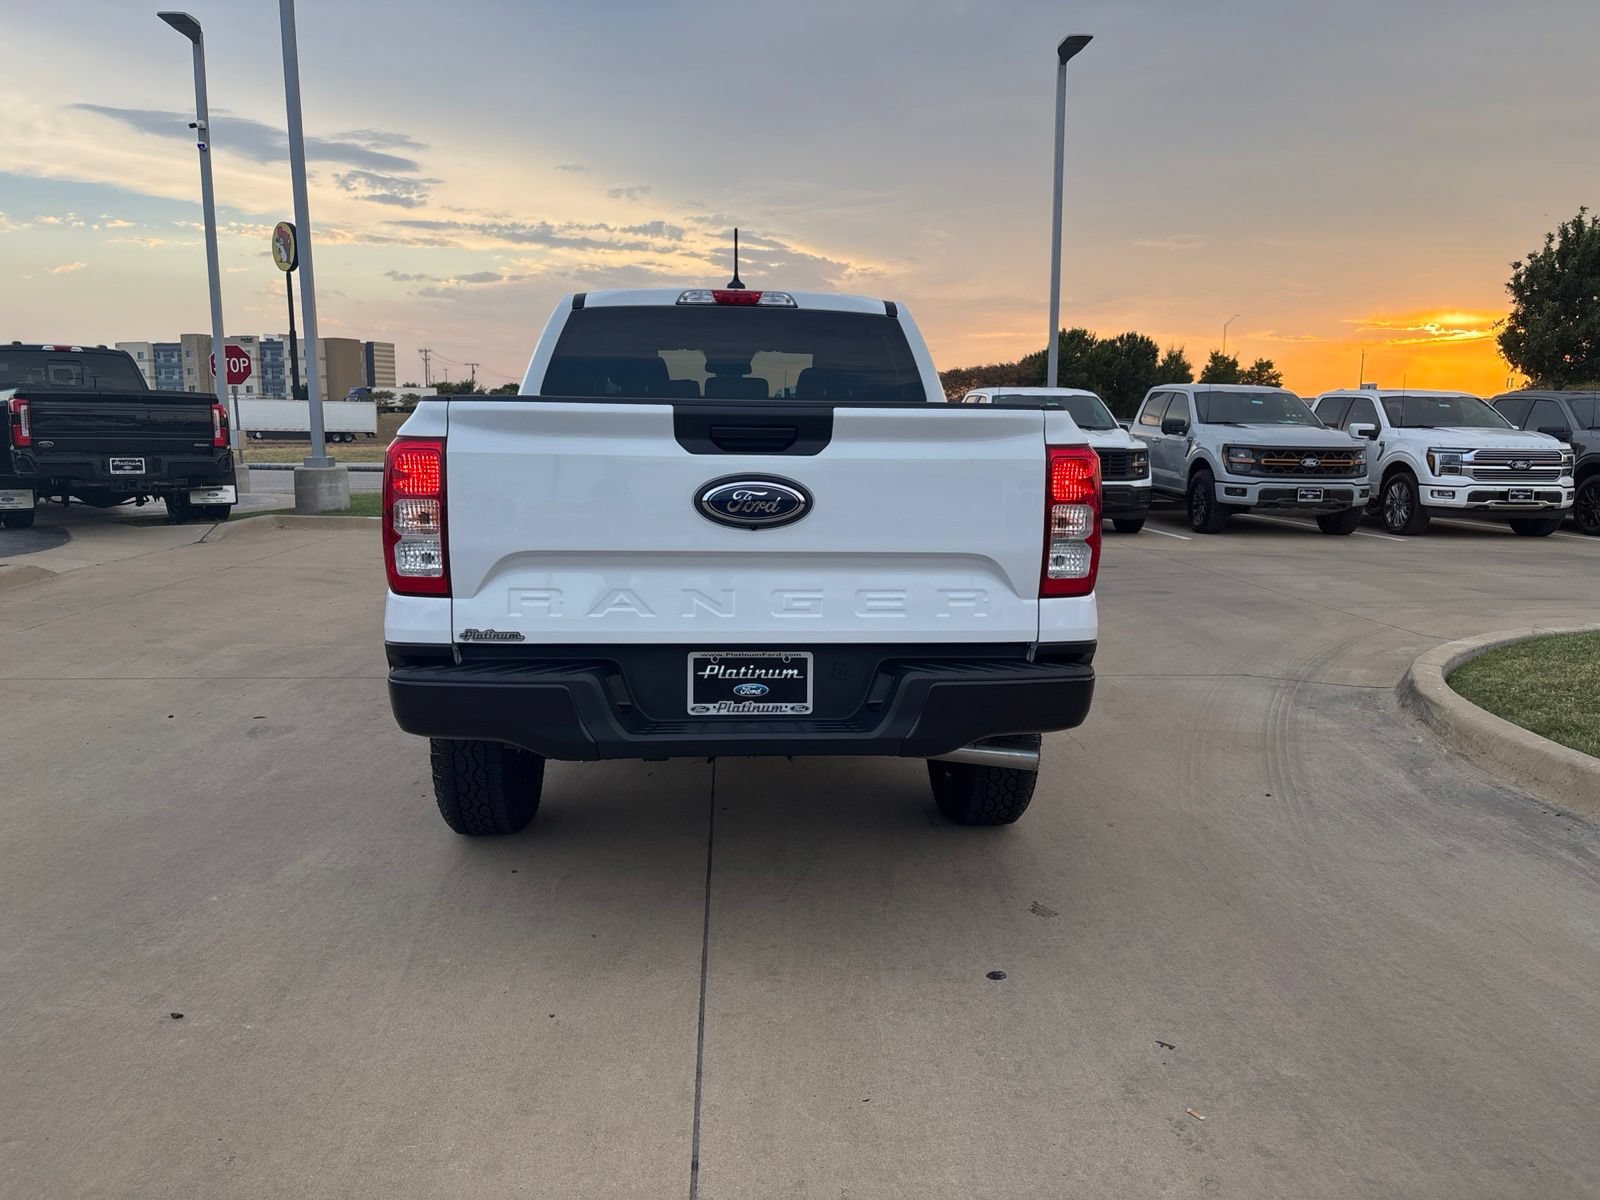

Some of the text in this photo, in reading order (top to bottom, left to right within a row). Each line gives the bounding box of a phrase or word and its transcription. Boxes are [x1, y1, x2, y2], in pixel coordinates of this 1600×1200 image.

[213, 357, 249, 373] TOP
[727, 489, 781, 513] Ford
[507, 587, 989, 618] RANGER
[460, 629, 525, 641] Platinum
[697, 665, 804, 679] Platinum
[740, 685, 762, 695] Ford
[717, 701, 788, 713] Platinum
